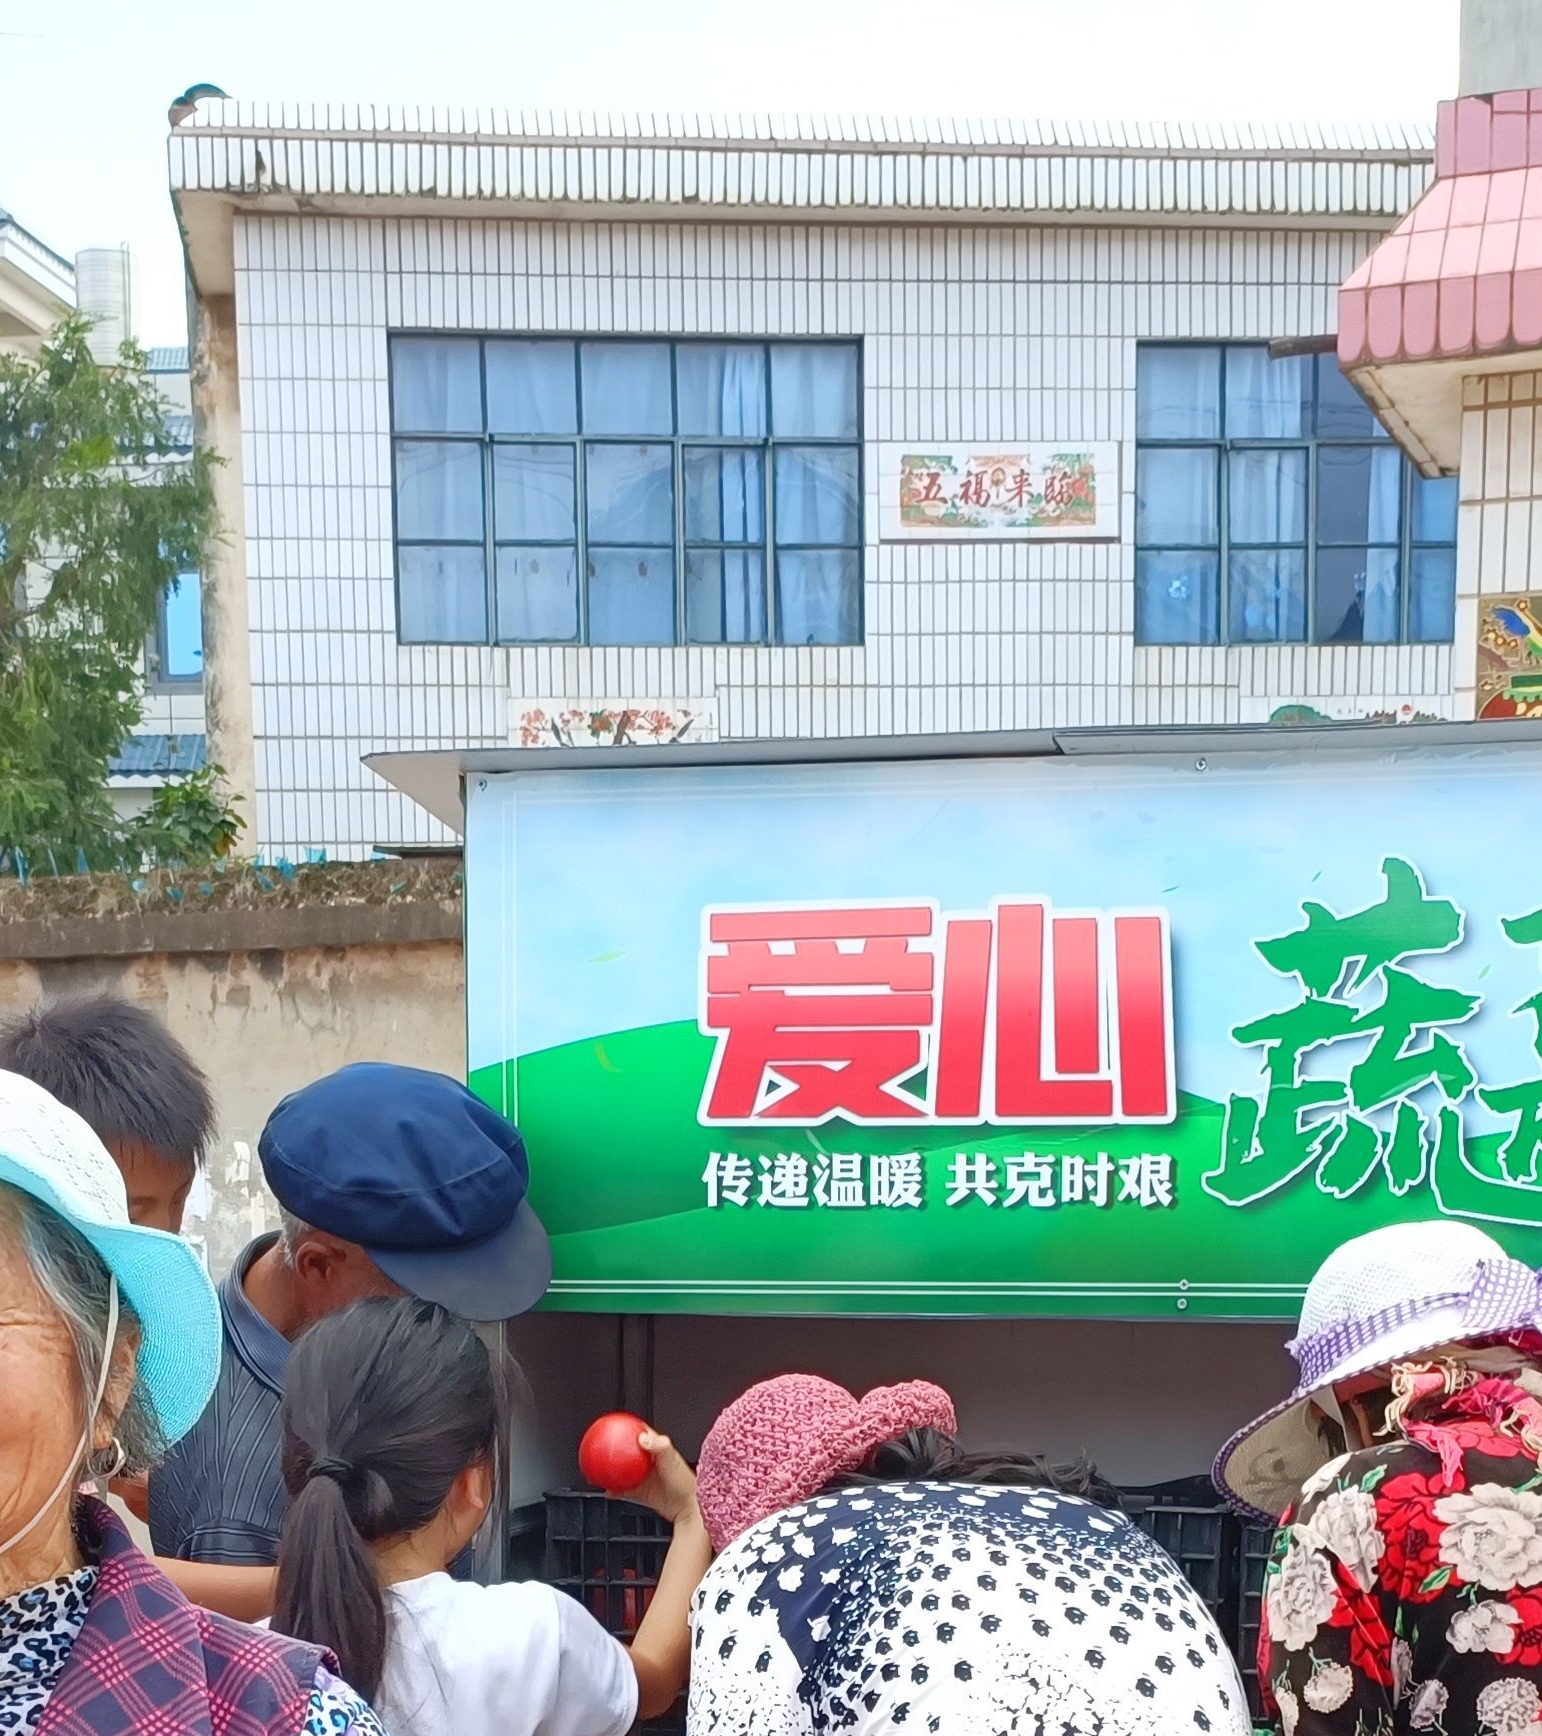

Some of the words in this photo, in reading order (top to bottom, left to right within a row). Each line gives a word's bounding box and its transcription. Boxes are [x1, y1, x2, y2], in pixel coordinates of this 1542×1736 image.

[702, 898, 1174, 1123] 爱心
[701, 1151, 925, 1208] 传递温暖
[945, 1151, 1175, 1208] 共克时艰
